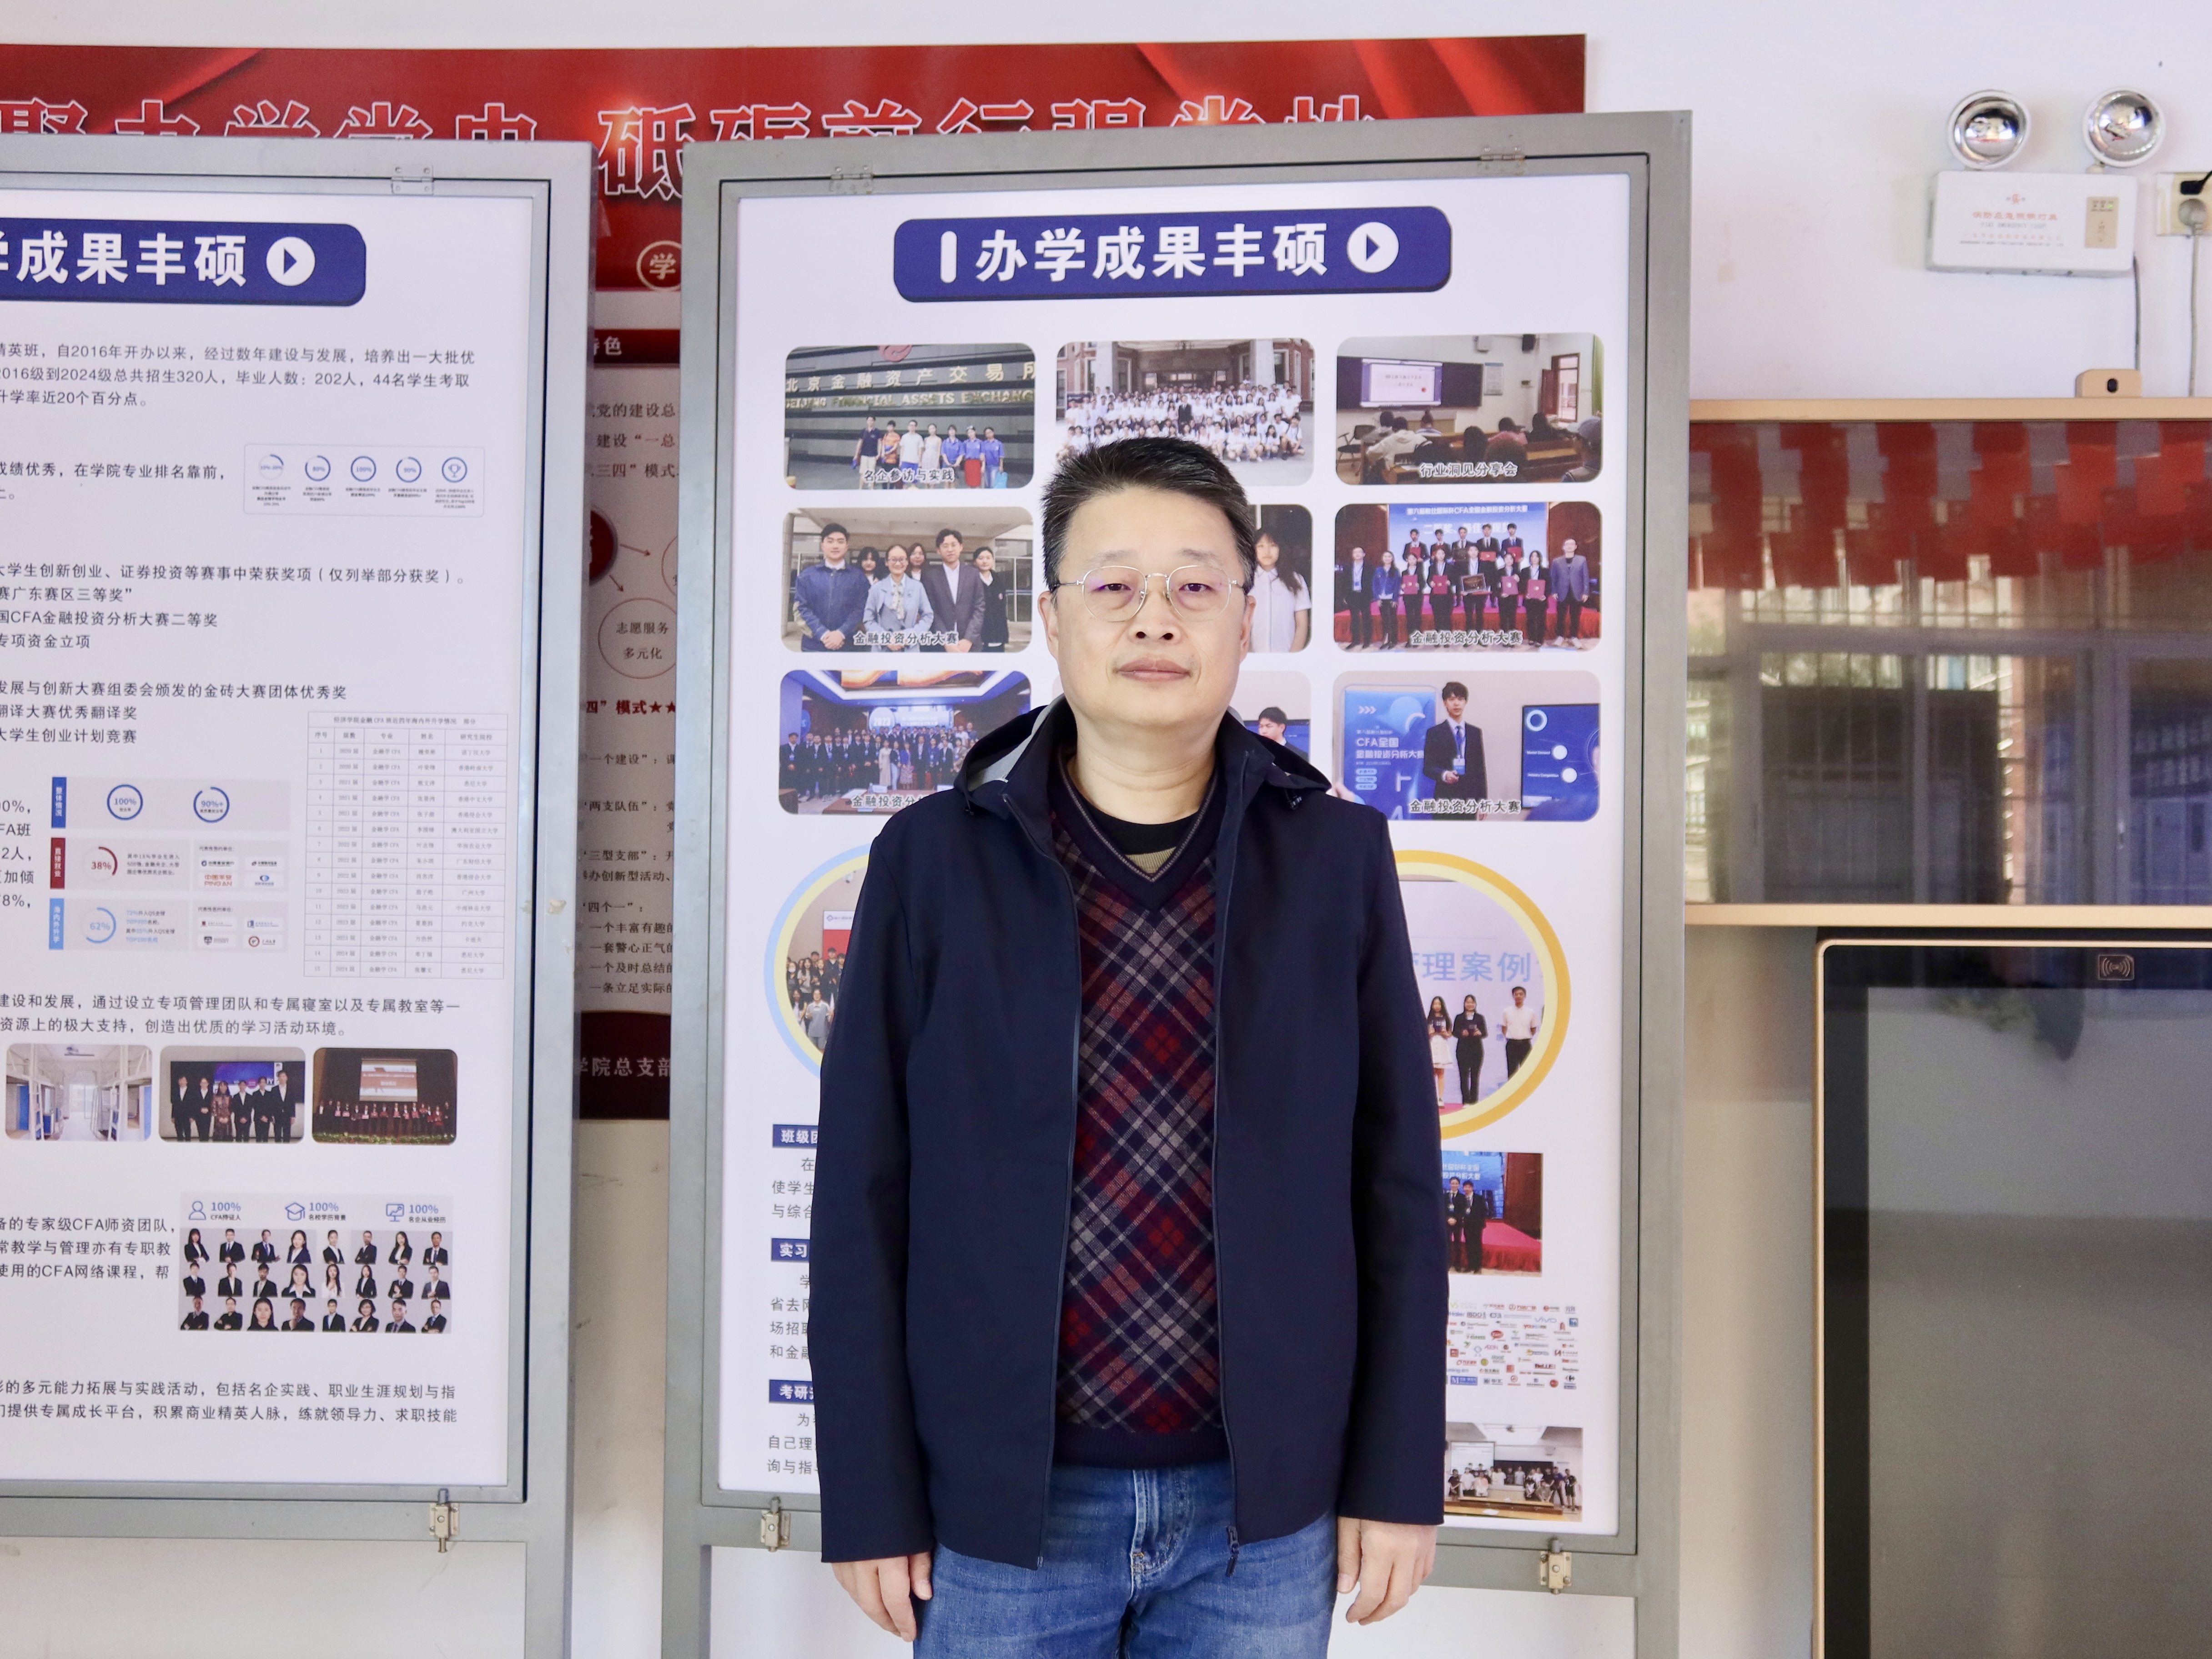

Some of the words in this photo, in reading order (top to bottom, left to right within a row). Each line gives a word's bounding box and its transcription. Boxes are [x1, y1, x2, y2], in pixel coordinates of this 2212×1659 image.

[0, 230, 247, 287] 成果丰硕
[975, 223, 1327, 282] 办学成果丰硕
[0, 367, 469, 391] 016级到2024级总共招生320人，毕业人数：202人，44名学生考取
[862, 467, 956, 484] 名企参访与实践
[1418, 461, 1518, 478] 行业洞见分享会
[0, 610, 217, 627] 国CFA金融投资分析大赛二等奖
[615, 622, 669, 634] 志愿服务
[0, 633, 90, 649] 专项资金立项
[851, 630, 960, 647] 金融投资分析大赛
[1410, 629, 1524, 646] 金融投资分析大赛
[623, 647, 662, 659] 多元化
[0, 680, 346, 699] 发展与创新大赛组委会颁发的金砖大赛团体优秀奖
[0, 704, 136, 720] 翻译大赛优秀翻译奖
[460, 733, 493, 741] 研究生院校
[0, 800, 30, 814] 0%，
[1408, 797, 1522, 815] 金融投资分析大赛
[91, 861, 112, 870] 38%
[0, 894, 30, 908] 8%，
[1411, 951, 1532, 982] 理案例
[0, 993, 460, 1014] 建设和发展，通过设立专项管理团队和专属寝室以及专属教室等一
[0, 1016, 344, 1036] 资源上的极大支持，创造出优质的学习活动环境。
[801, 1157, 815, 1172] 在
[772, 1181, 814, 1195] 使学生
[211, 1202, 241, 1212] 100%
[309, 1202, 339, 1212] 100%
[409, 1204, 438, 1214] 100%
[210, 1214, 241, 1222] CFA持证人
[308, 1214, 347, 1223] 名校学历背景
[408, 1216, 447, 1225] 名企从业经历
[0, 1240, 171, 1256] 常教学与管理亦有专职教
[779, 1242, 808, 1258] 实习
[0, 1263, 169, 1279] 使用的CFA网络课程，帮
[0, 1380, 455, 1399] 的多元能力拓展与实践活动，包括名企实践、职业生涯规划与指
